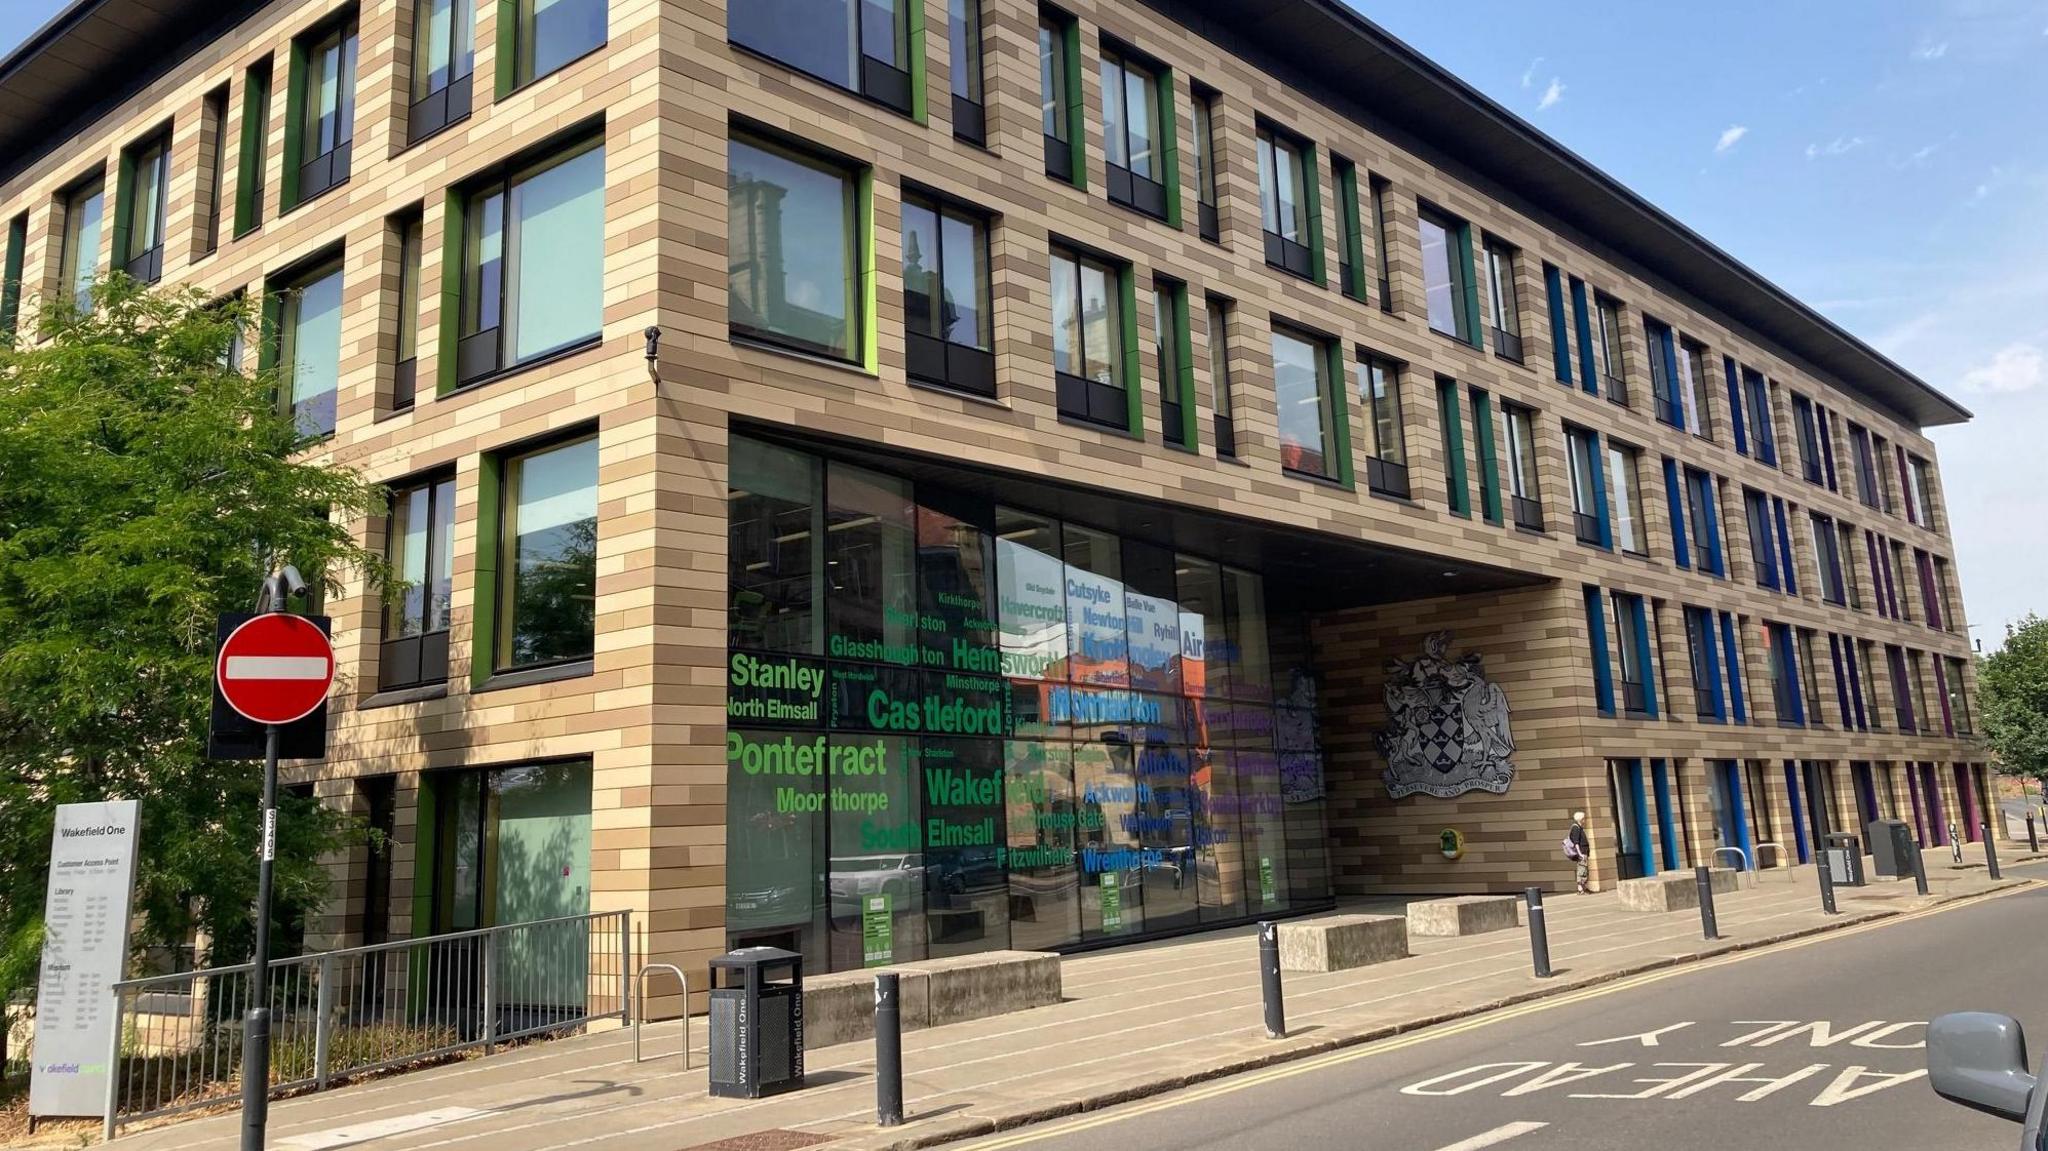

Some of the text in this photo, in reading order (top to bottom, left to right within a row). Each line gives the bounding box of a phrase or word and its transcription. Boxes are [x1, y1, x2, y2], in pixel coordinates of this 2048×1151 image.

[1067, 579, 1111, 604] Cutsyke
[1083, 606, 1125, 630] Newton
[1154, 622, 1179, 641] Ryhill
[830, 634, 945, 666] Glasshoughton
[731, 653, 825, 698] Stanley
[946, 674, 1000, 694] Minsthorpe
[767, 699, 818, 720] Elmsall
[868, 689, 1000, 735] Castleford
[727, 732, 887, 775] Pontefract
[777, 787, 888, 814] Moorthorpe
[61, 825, 126, 838] Wakefield One
[267, 810, 276, 858] S3405
[928, 817, 994, 847] Elmsall
[738, 999, 748, 1085] Wakefield One
[794, 1019, 804, 1078] Wakefield
[1400, 1061, 1928, 1106] AHEAD
